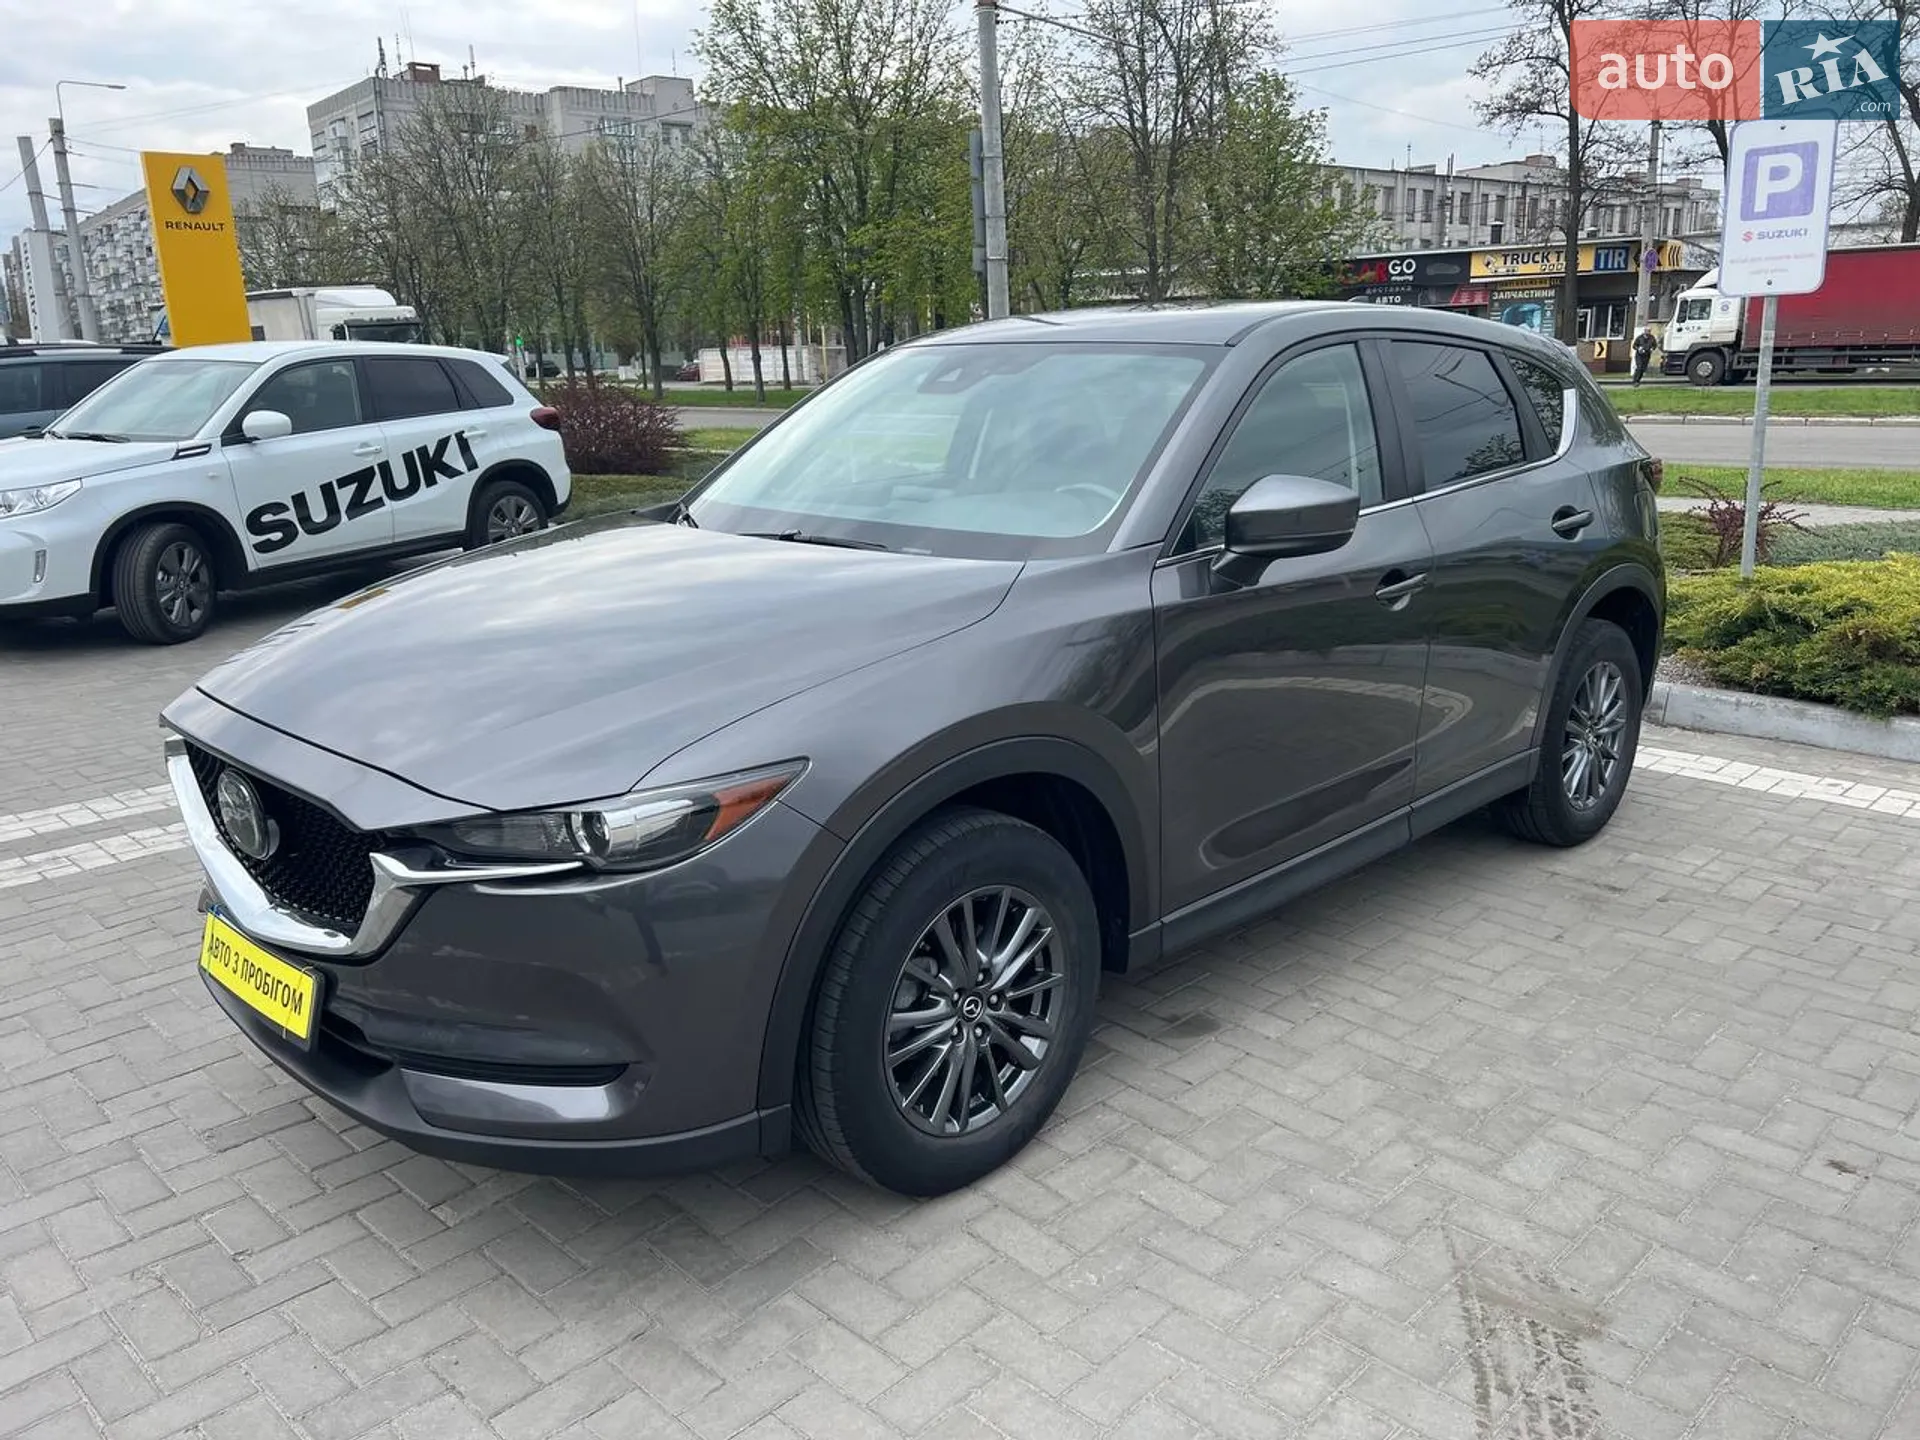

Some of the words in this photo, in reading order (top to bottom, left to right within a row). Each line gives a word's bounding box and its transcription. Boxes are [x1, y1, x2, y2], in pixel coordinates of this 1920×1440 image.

[1753, 152, 1804, 213] P
[165, 220, 225, 232] RENAULT
[1756, 228, 1808, 240] SUZUKI
[1501, 251, 1551, 265] TRUCK
[1597, 249, 1626, 269] TIR
[1492, 289, 1555, 300] ЗАПЧАСТИНИ
[246, 430, 479, 554] SUZUKI
[208, 933, 231, 967] АВТО
[240, 958, 304, 1016] ПРОБІГОМ
